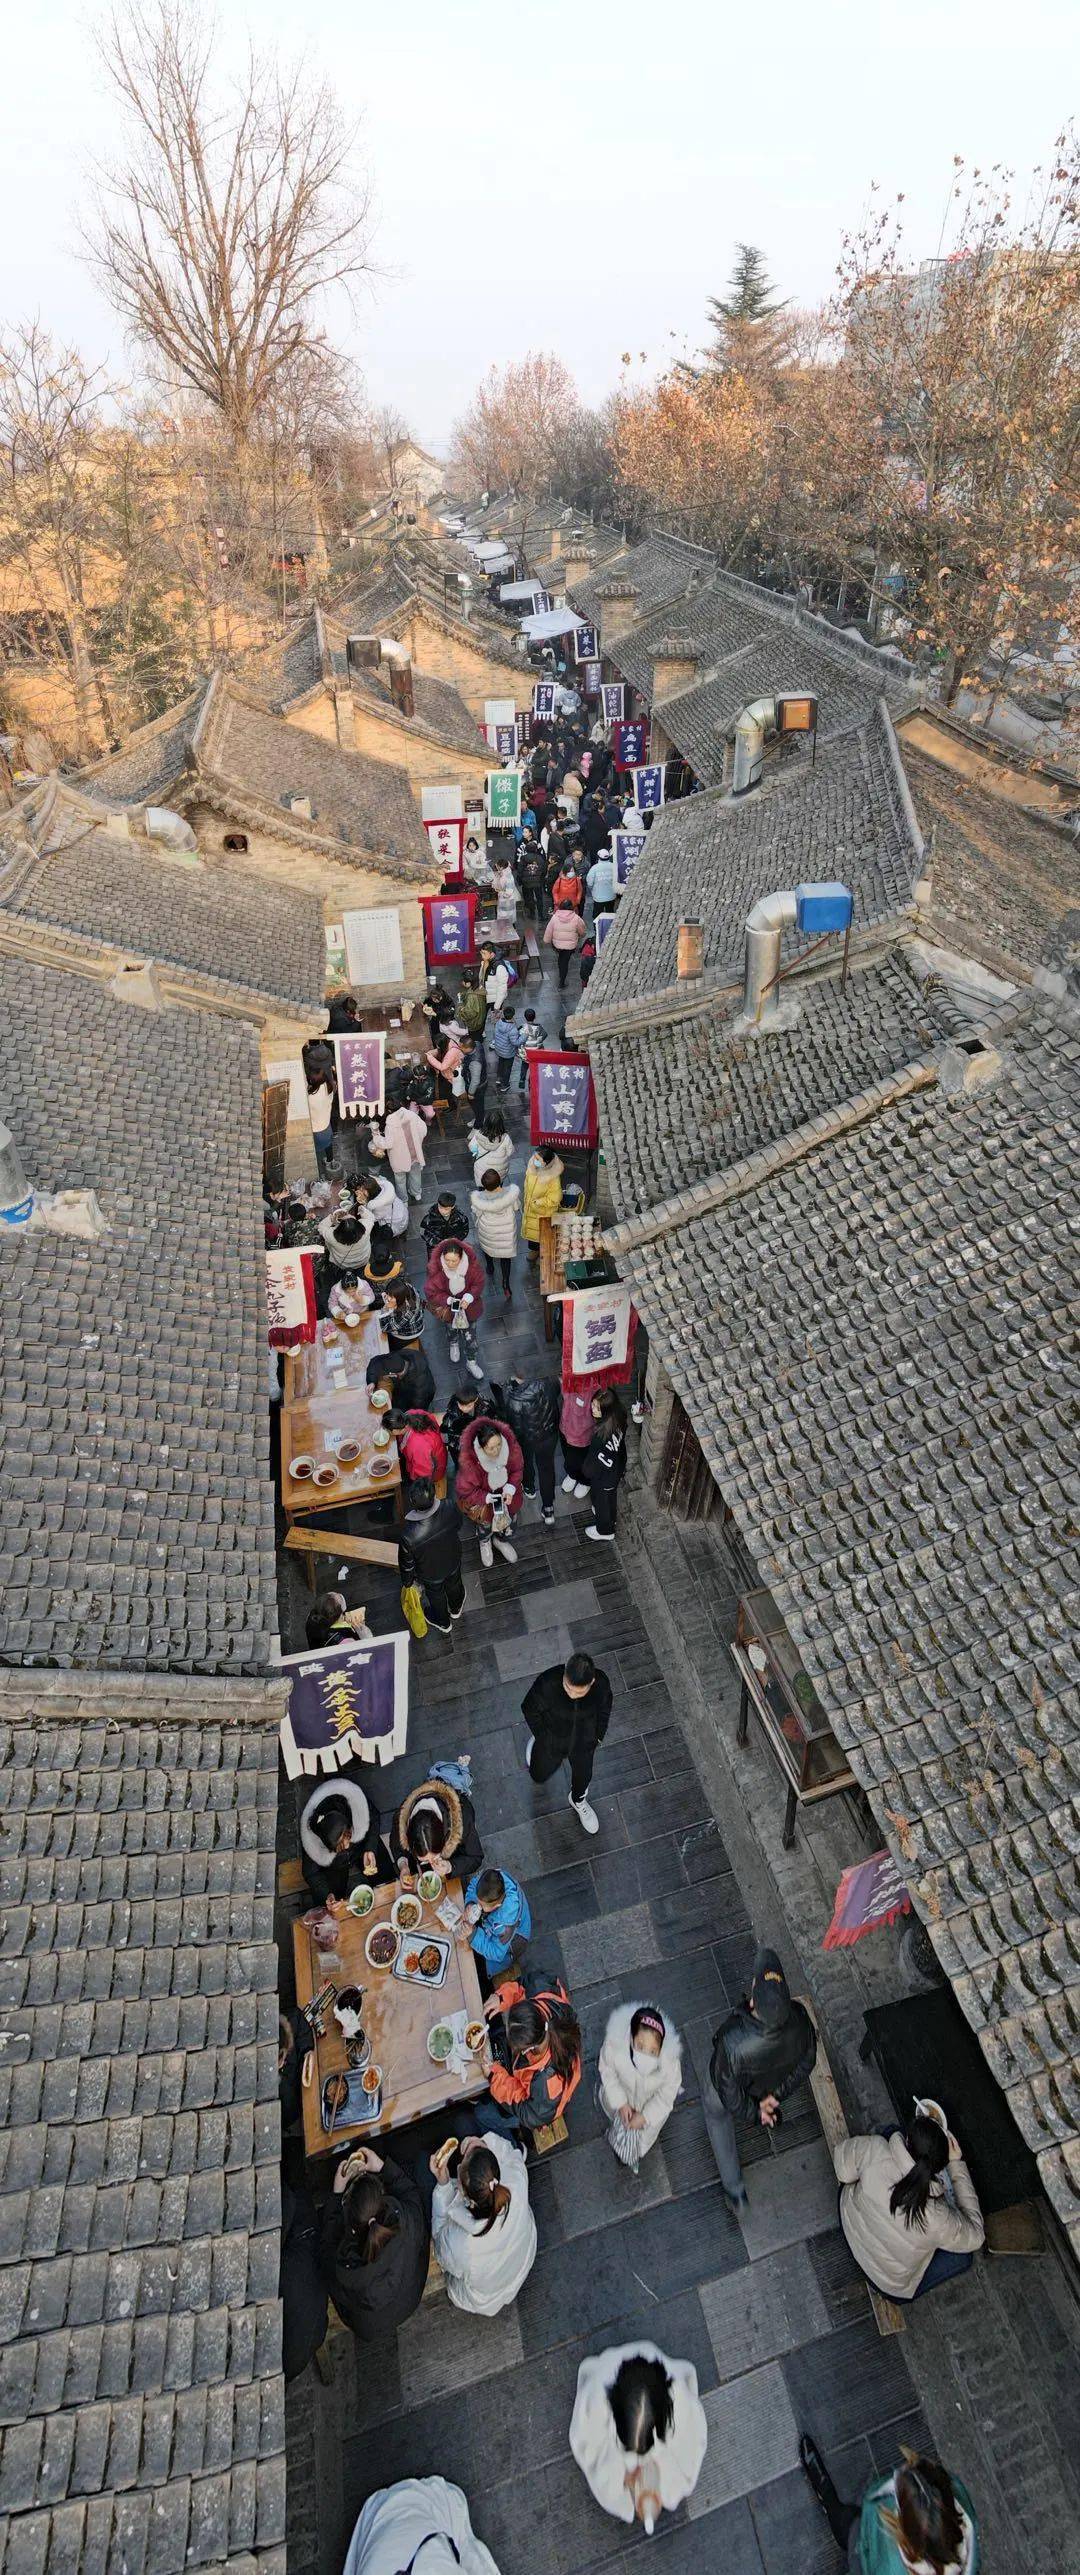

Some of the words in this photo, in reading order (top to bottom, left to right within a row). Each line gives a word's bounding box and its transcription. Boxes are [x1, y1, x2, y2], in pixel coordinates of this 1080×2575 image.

[623, 733, 637, 763] 扁豆面
[495, 777, 514, 814] 馓子
[541, 1064, 585, 1080] 袁家村
